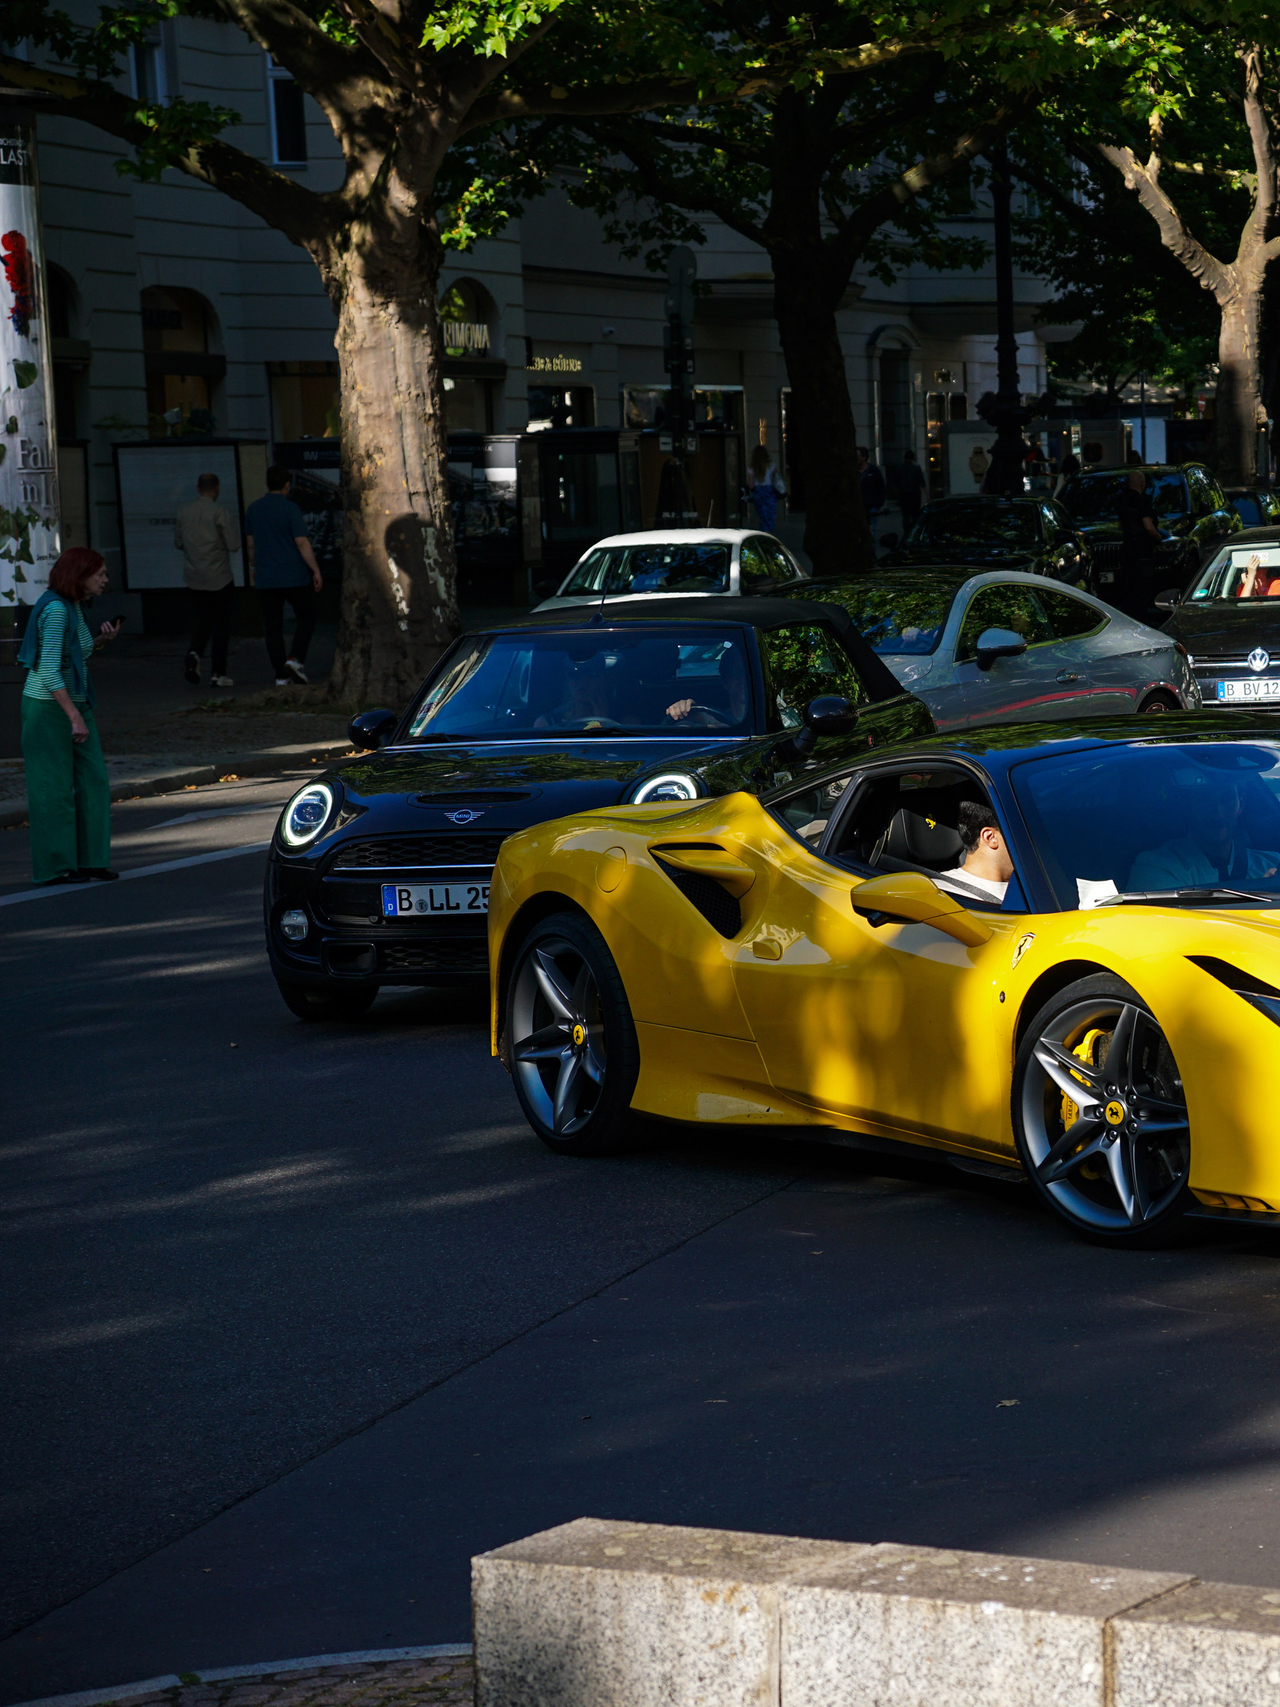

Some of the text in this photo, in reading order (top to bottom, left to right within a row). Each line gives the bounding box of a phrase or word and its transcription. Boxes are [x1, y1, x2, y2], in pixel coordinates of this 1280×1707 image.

[443, 322, 491, 349] RIMOWA
[1226, 684, 1235, 696] B
[1243, 682, 1260, 695] BV
[398, 888, 413, 912] B
[429, 887, 460, 911] LL
